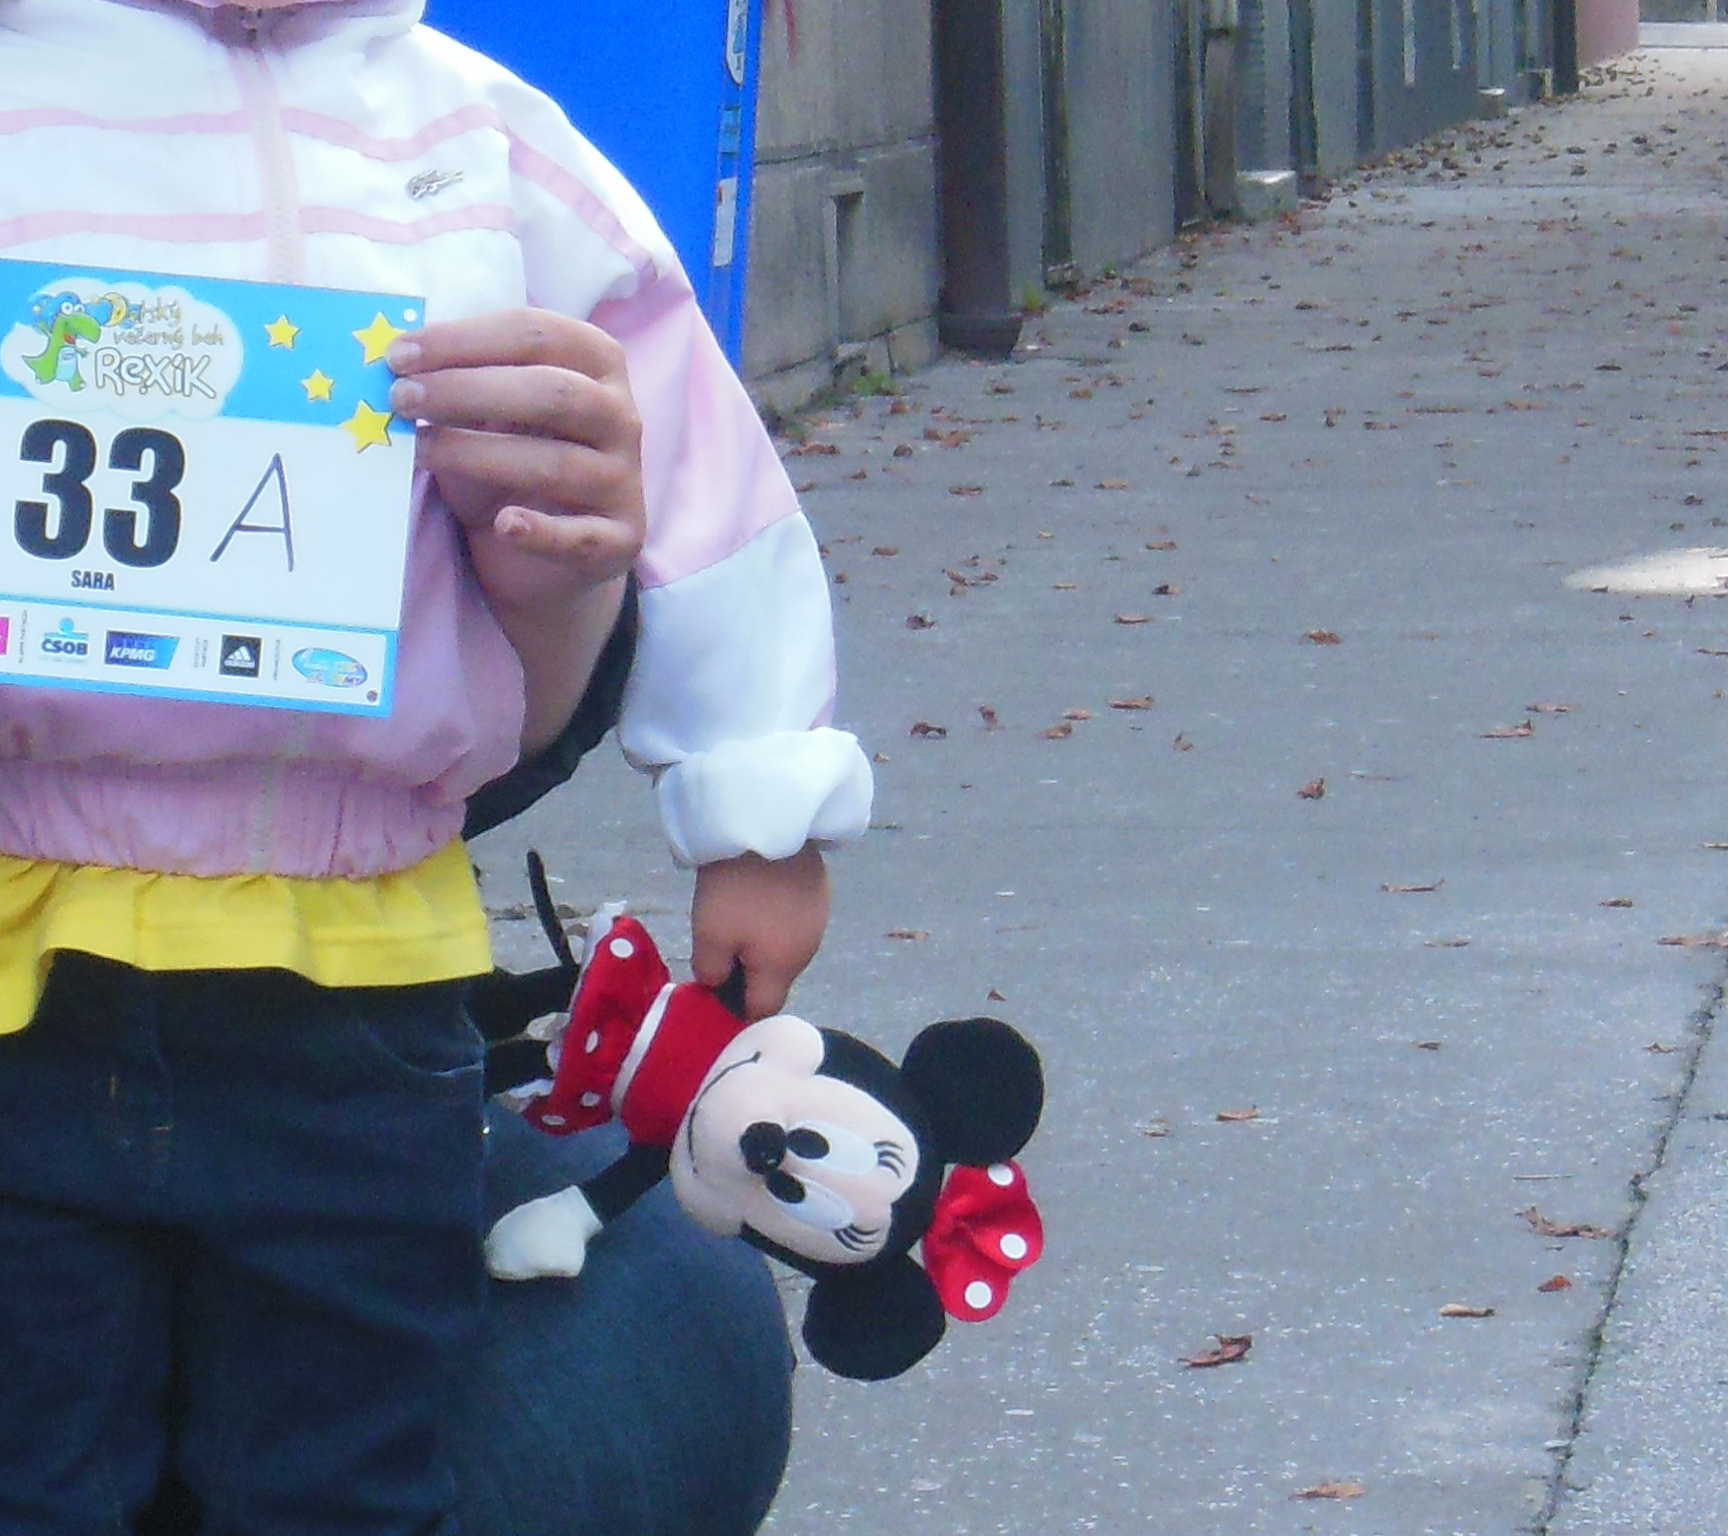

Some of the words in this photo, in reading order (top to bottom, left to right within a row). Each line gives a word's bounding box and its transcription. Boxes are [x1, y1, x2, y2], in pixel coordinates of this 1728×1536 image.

[13, 418, 186, 569] 33
[209, 452, 294, 572] A
[70, 568, 115, 591] SARA
[110, 646, 156, 662] KPMG
